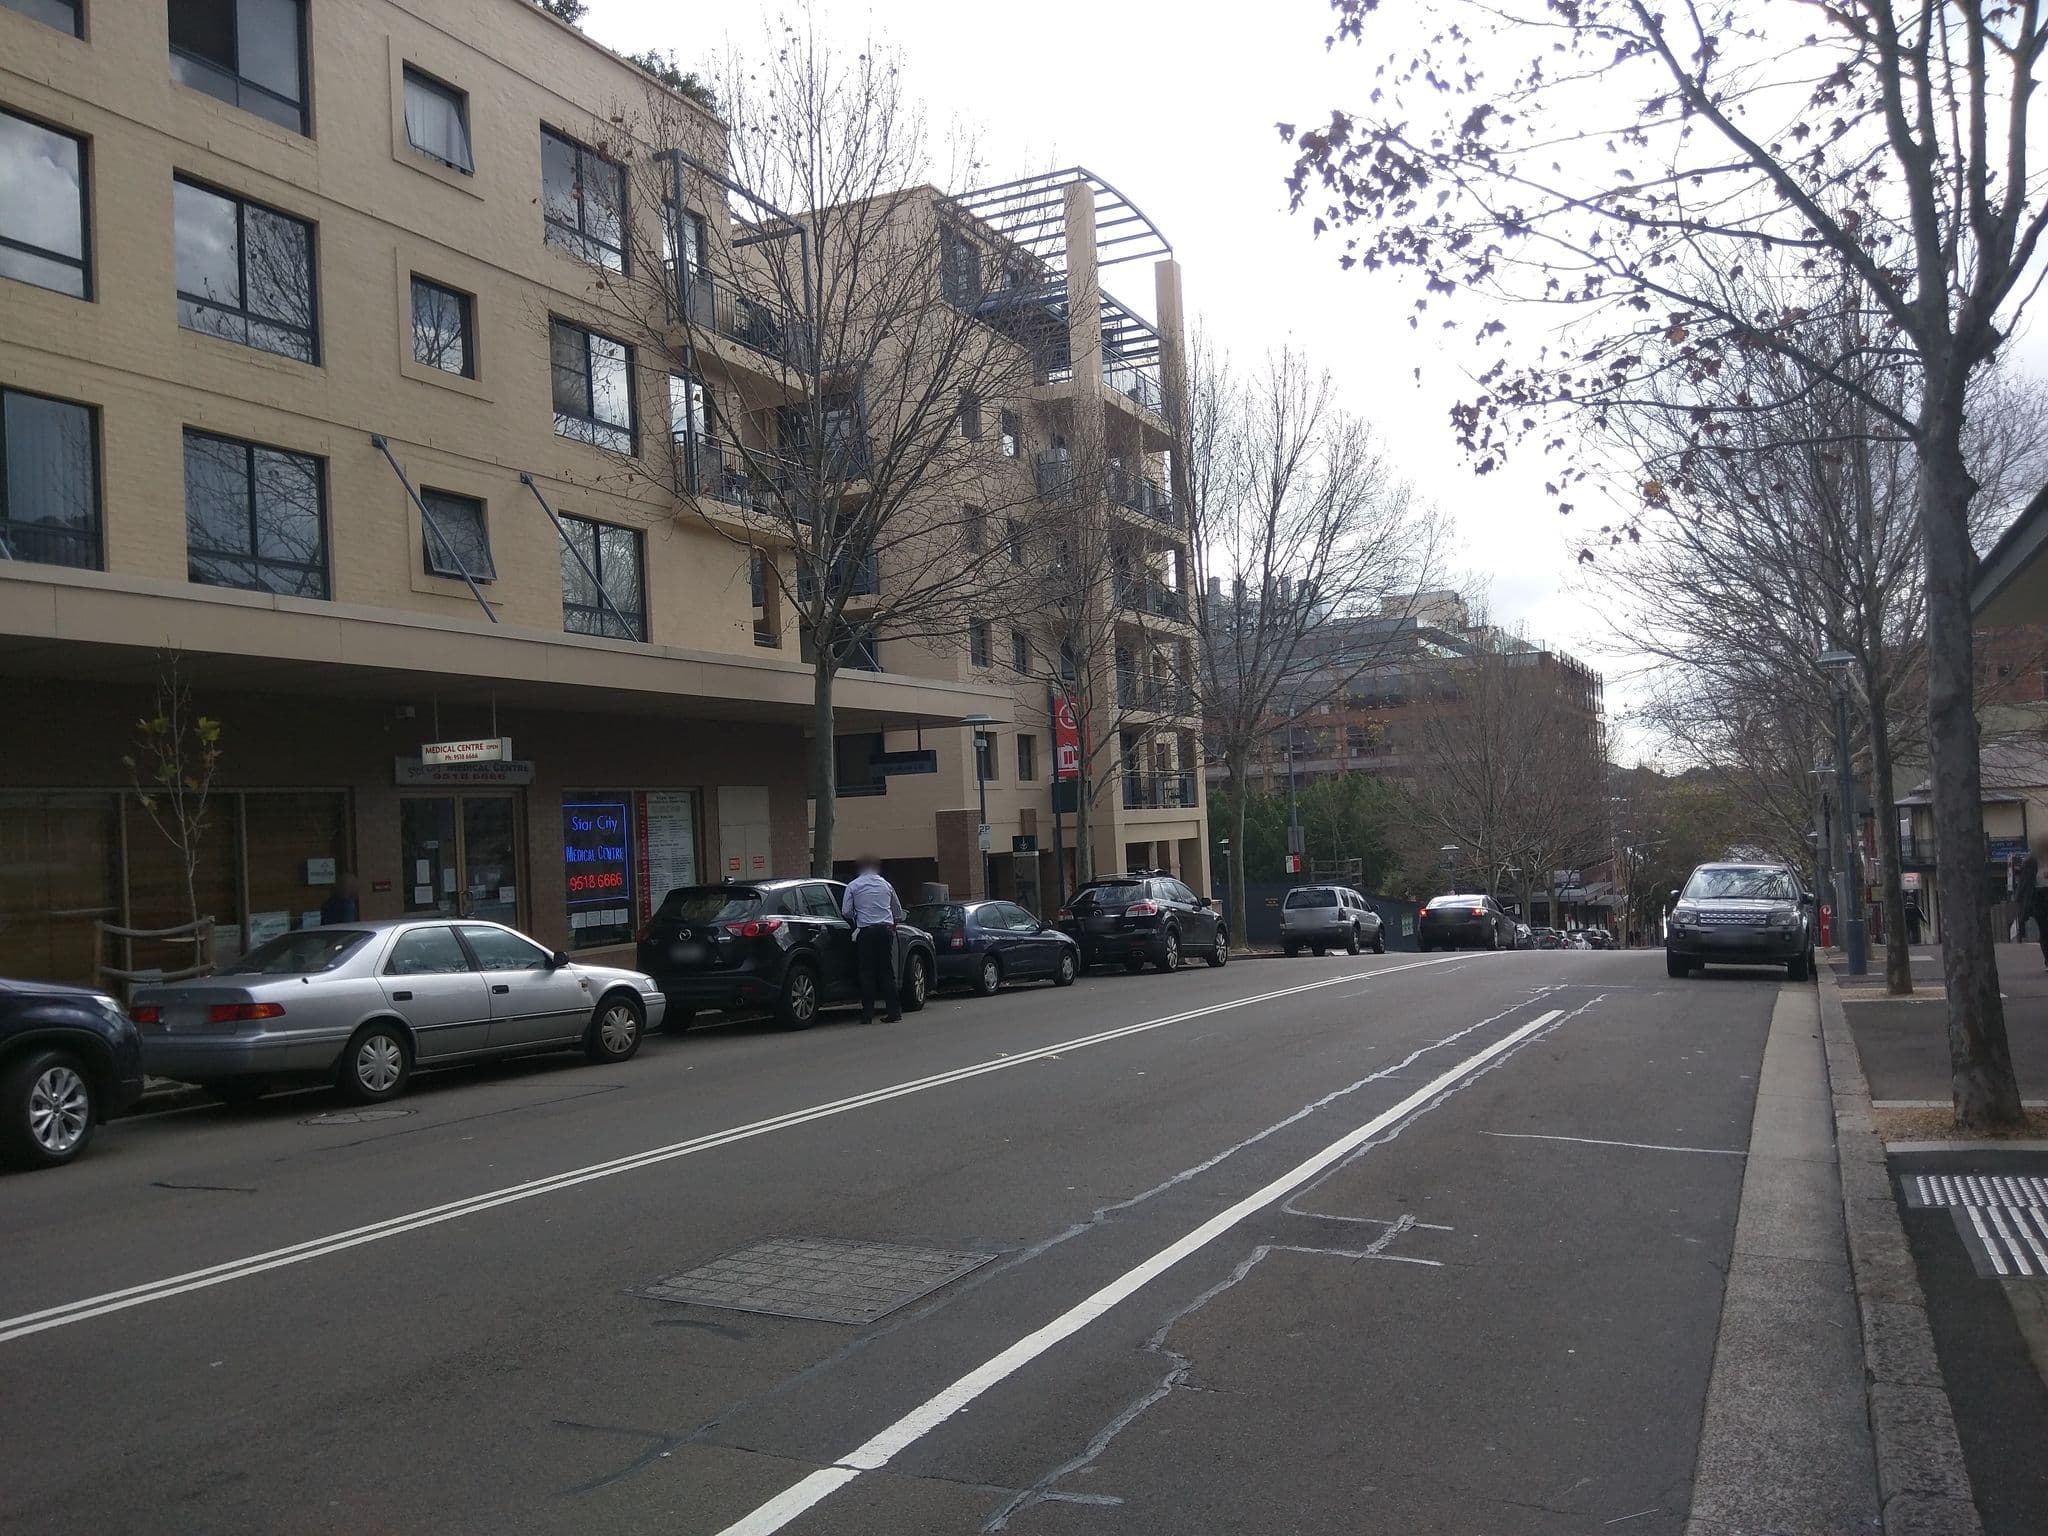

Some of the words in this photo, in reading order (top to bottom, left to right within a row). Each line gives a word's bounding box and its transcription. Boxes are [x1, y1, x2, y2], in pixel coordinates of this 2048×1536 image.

[425, 745, 455, 754] MEDICAL
[457, 743, 484, 752] CENTRE
[572, 816, 593, 831] Star
[597, 816, 618, 833] City
[980, 825, 991, 833] 2P
[566, 846, 595, 863] MEDICAL
[569, 875, 595, 891] 9518
[597, 873, 623, 888] 6666
